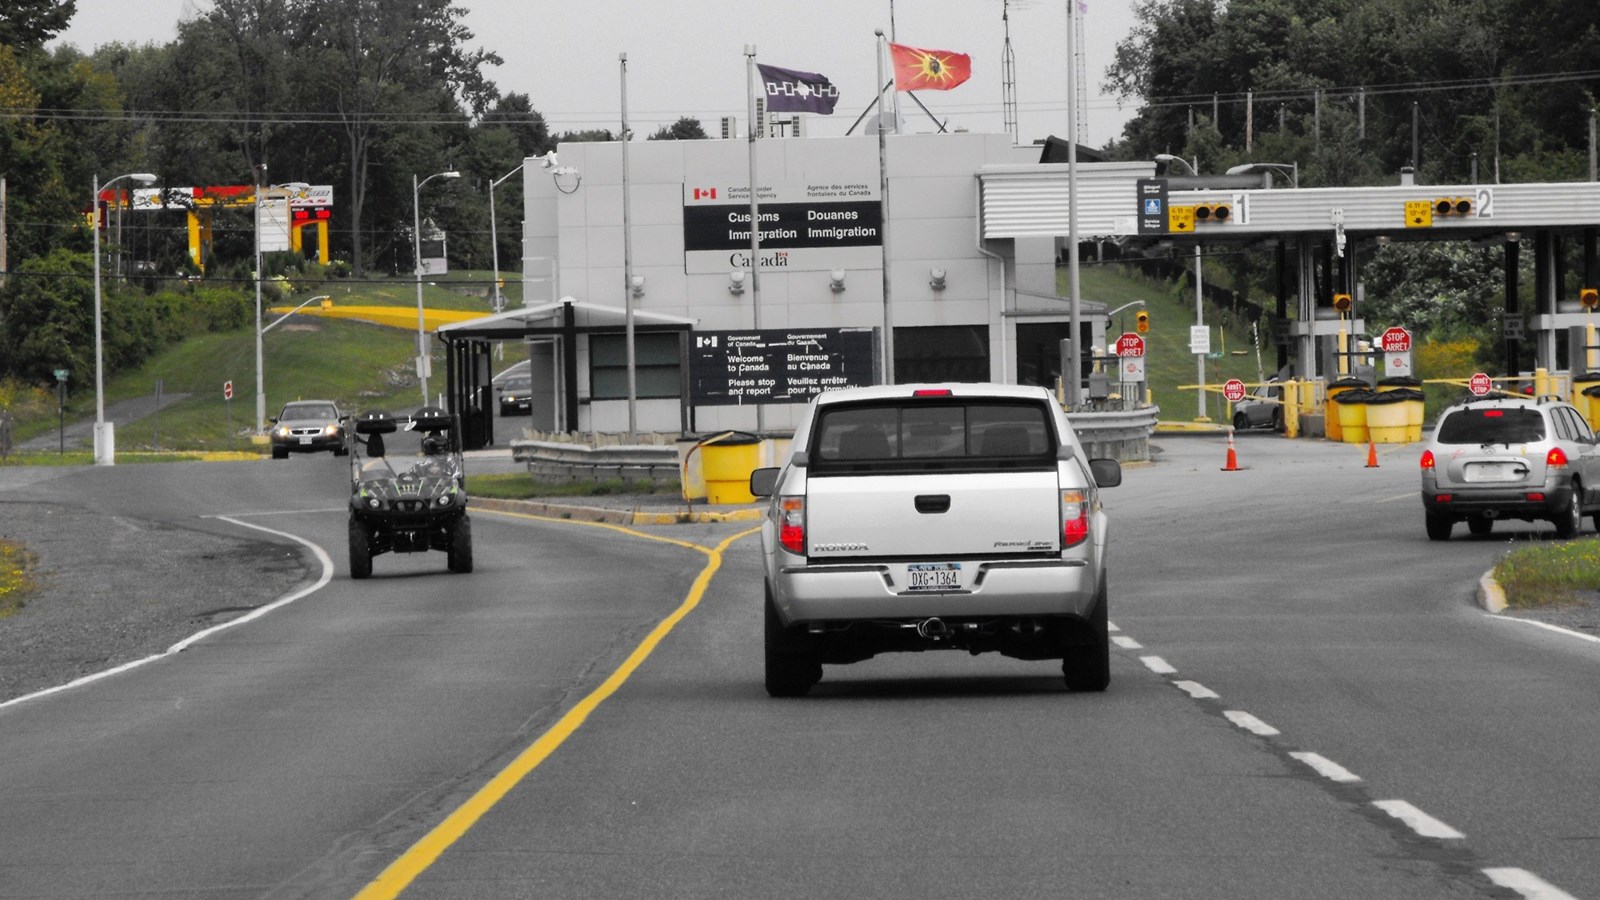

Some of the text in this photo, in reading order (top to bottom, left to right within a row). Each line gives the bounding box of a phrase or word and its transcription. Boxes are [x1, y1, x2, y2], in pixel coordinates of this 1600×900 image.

[1478, 190, 1491, 218] 2
[1236, 195, 1246, 224] 1
[728, 212, 780, 222] Cusoms
[808, 210, 858, 221] Douanes
[729, 228, 798, 242] Immgration
[808, 226, 876, 240] Immigration
[730, 252, 788, 268] Caada
[1122, 338, 1139, 347] STOP
[1387, 333, 1405, 342] STOP
[787, 354, 829, 362] Bienvenue
[800, 362, 830, 370] Canada
[758, 379, 776, 387] stop
[746, 388, 771, 396] report
[788, 386, 806, 396] pour
[814, 543, 870, 552] HONDA
